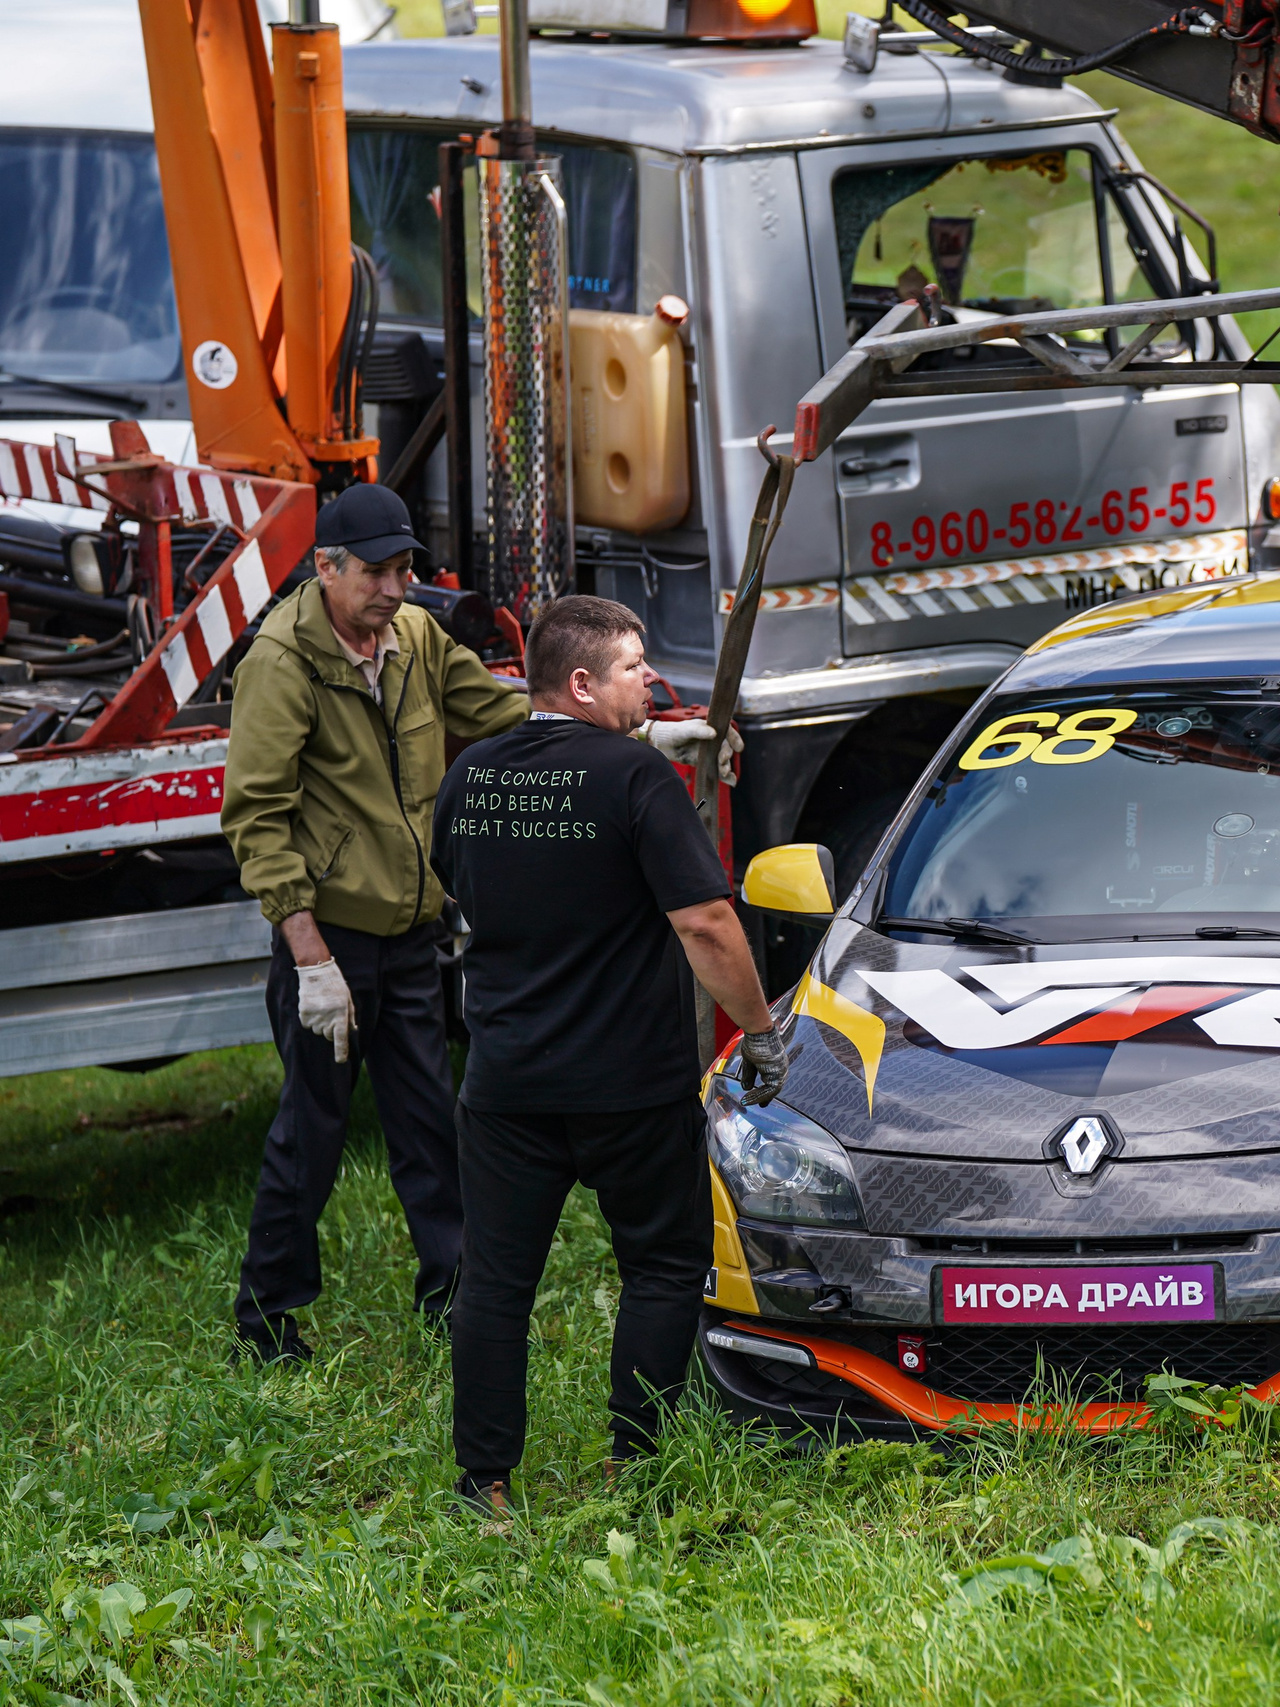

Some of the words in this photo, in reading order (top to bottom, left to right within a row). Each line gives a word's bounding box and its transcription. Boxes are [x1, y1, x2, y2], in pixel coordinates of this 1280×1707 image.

[871, 478, 1217, 568] 8-960-582-65-55
[958, 708, 1138, 771] 68
[466, 766, 496, 785] THE
[500, 769, 587, 787] CONCERT
[465, 792, 501, 811] HAD
[508, 794, 555, 812] BEEN
[560, 795, 573, 813] A
[451, 817, 504, 837] GREAT
[511, 820, 597, 840] SUCCESS
[955, 1283, 1069, 1309] ИГОРА
[1077, 1275, 1204, 1313] ДРАЙВ
